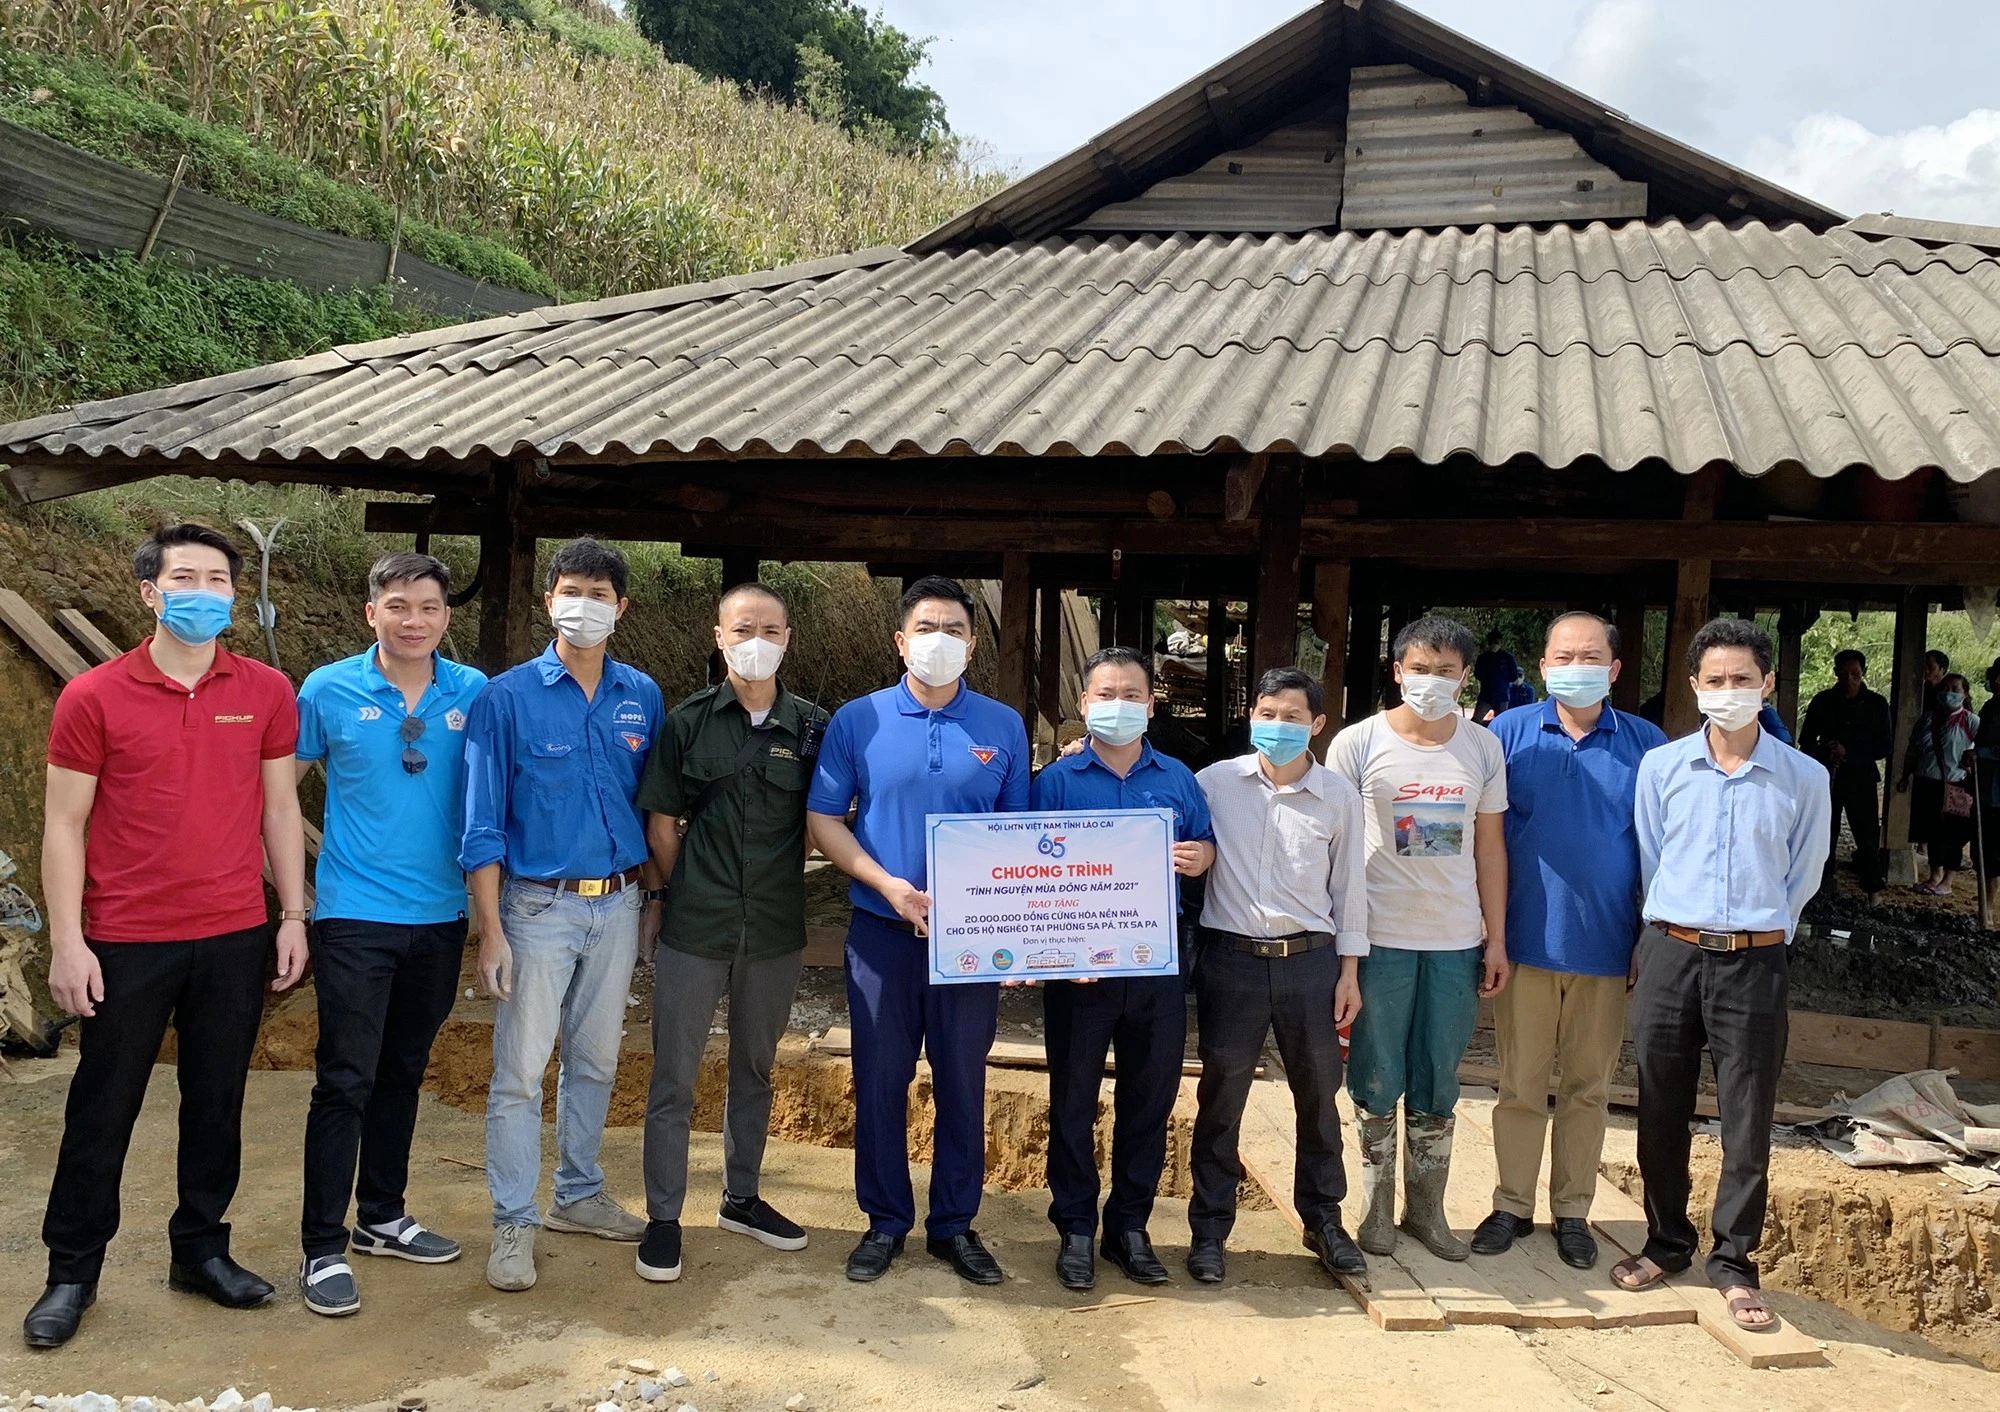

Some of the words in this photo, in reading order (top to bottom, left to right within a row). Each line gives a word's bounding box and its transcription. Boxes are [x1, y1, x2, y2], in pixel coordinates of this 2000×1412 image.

[1392, 783, 1464, 801] Sapa
[988, 823, 1003, 833] HỘI
[1004, 823, 1024, 831] LHTN
[1025, 822, 1042, 832] VIỆT
[1043, 822, 1061, 830] NAM
[1082, 820, 1098, 829] LÀO
[1100, 820, 1114, 828] CAI
[1037, 833, 1067, 859] 65
[991, 864, 1063, 880] CHƯƠNG
[1066, 861, 1113, 877] TRÌNH
[993, 884, 1033, 896] NGUYỆN
[1035, 882, 1056, 894] MÙA
[1090, 881, 1112, 892] NĂM
[1027, 900, 1052, 909] TRAO
[964, 914, 1021, 924] 20.000.000
[1120, 908, 1139, 918] NHÀ
[946, 927, 965, 935] CHO
[981, 925, 995, 935] HỘ
[996, 923, 1029, 933] NGHÈO
[1030, 924, 1045, 934] TẠI
[1046, 922, 1086, 931] PHƯỜNG
[1087, 922, 1100, 930] SA
[1118, 921, 1129, 929] TX
[1145, 920, 1158, 928] PA
[1023, 937, 1039, 945] Đơn
[1040, 937, 1047, 945] vị
[1049, 936, 1066, 945] thực
